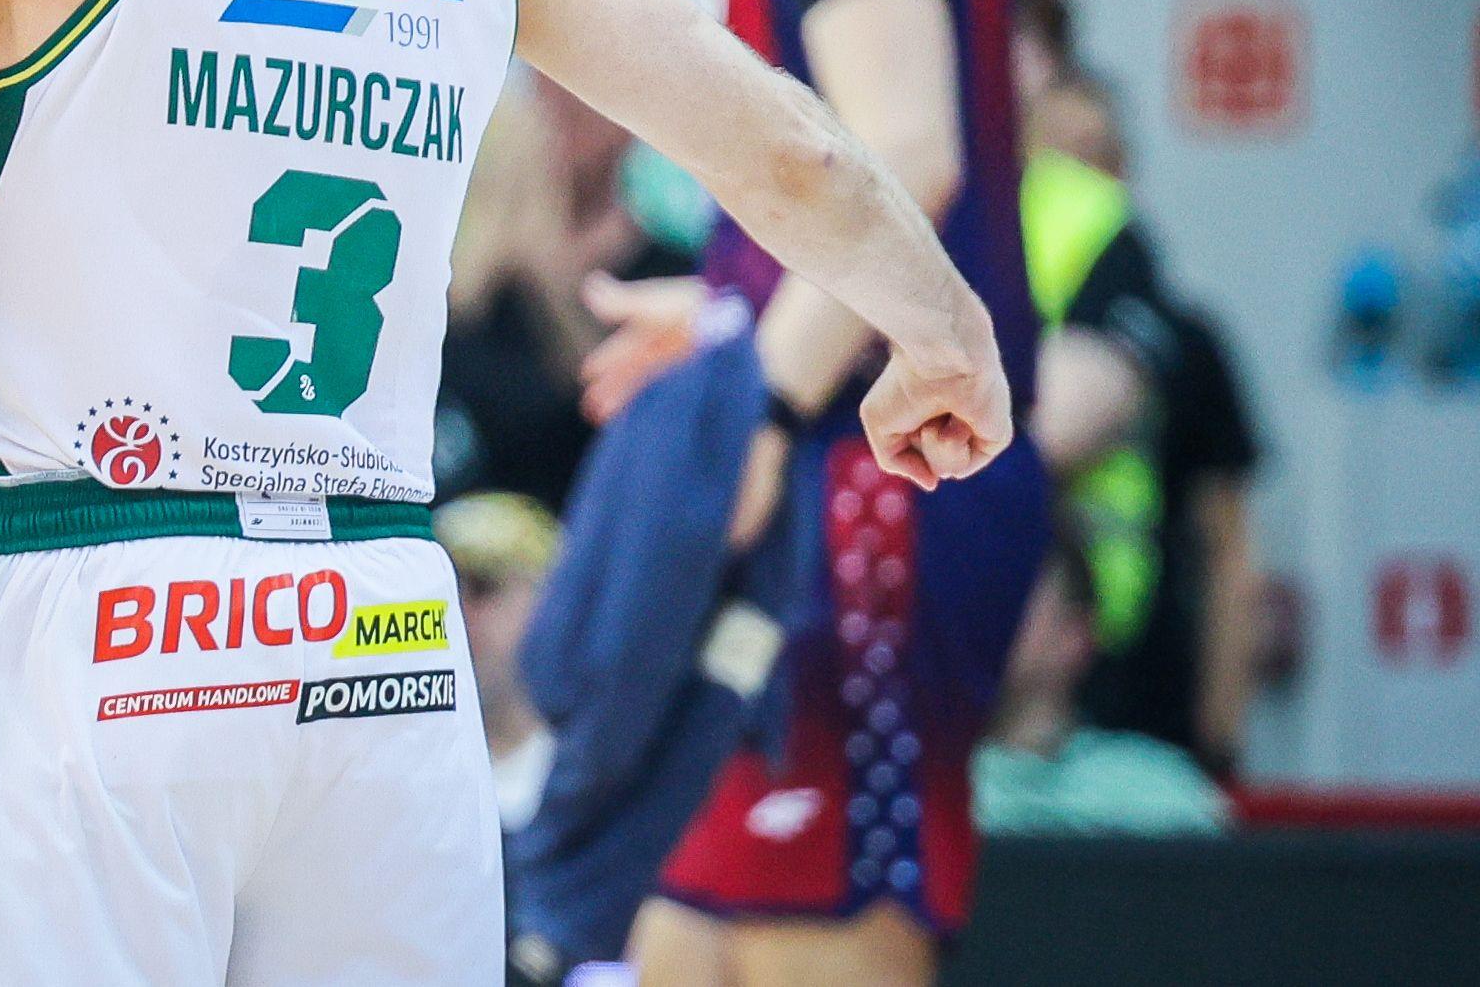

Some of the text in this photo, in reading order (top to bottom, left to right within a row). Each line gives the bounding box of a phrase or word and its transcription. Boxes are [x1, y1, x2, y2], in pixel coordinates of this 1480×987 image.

[384, 11, 440, 50] 1991
[166, 47, 465, 164] MAZURCZAK
[228, 169, 402, 419] 3
[203, 436, 403, 474] Kostrzyńsko-Słubic
[312, 471, 367, 494] Strefa
[93, 569, 348, 665] BRICO
[104, 674, 455, 716] CENTRUM HANDLOWE POMORSKIE
